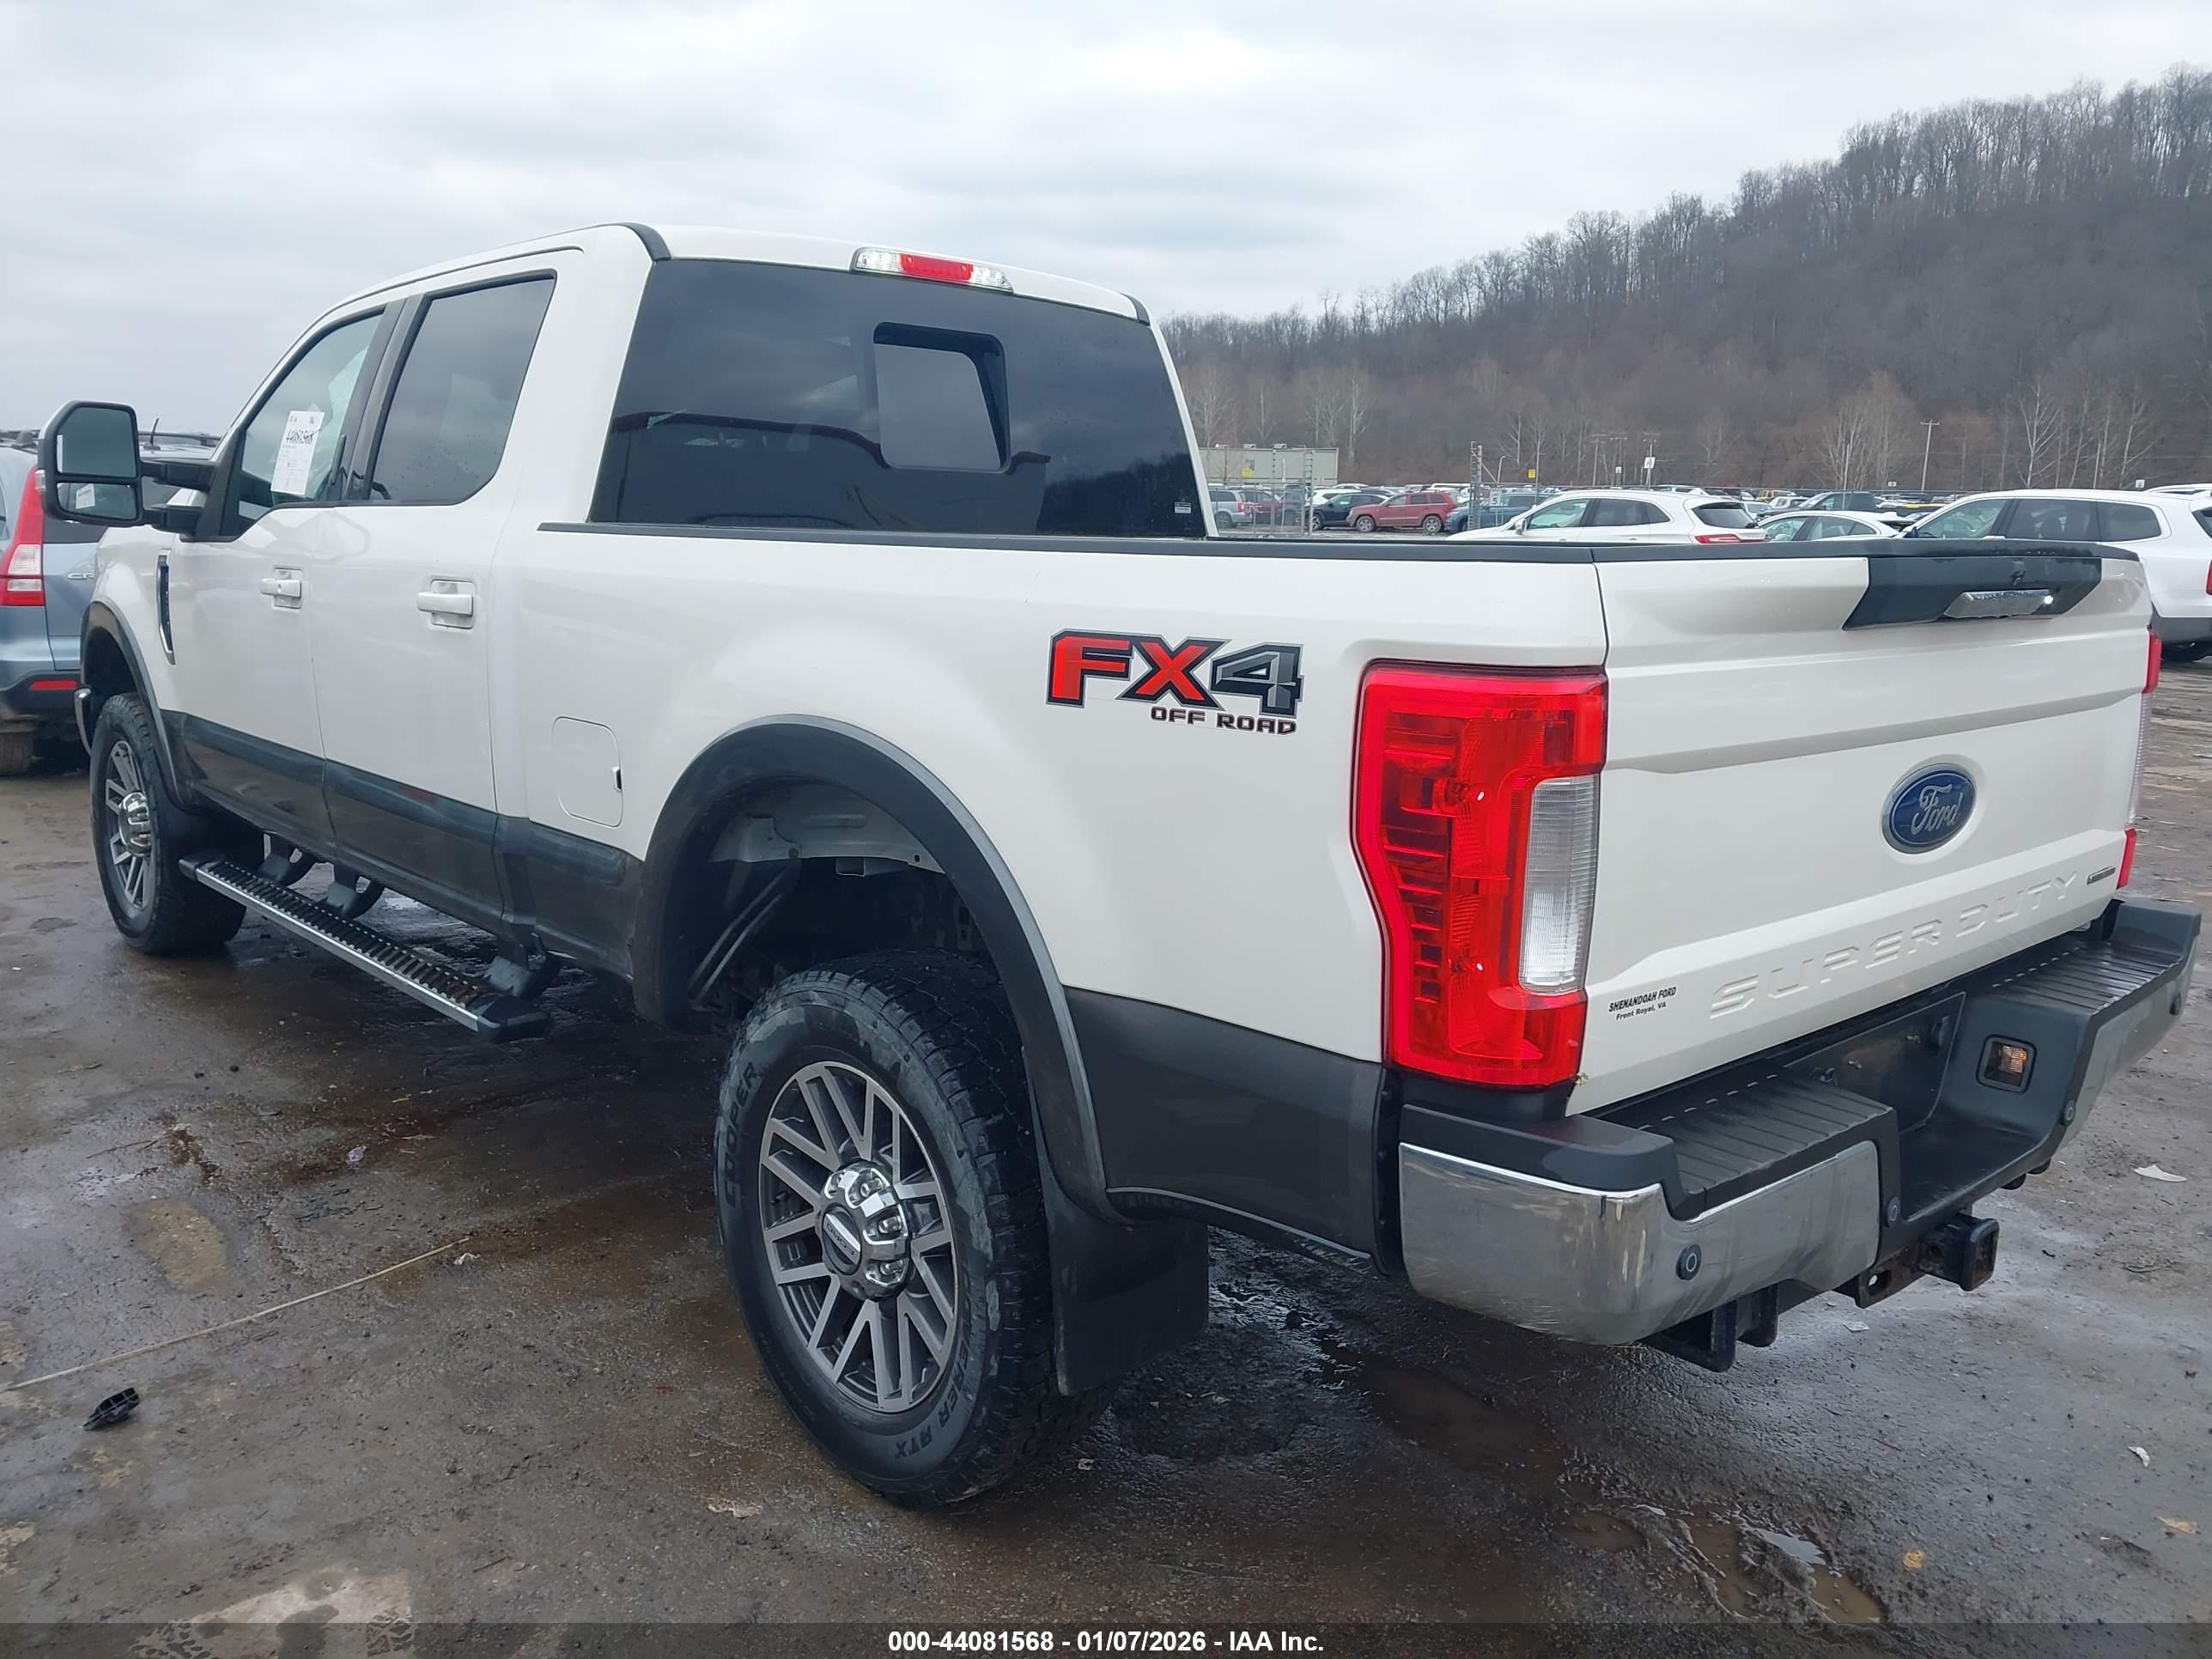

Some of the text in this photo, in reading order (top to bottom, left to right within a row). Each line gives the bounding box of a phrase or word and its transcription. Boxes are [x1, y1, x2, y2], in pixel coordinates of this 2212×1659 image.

[1046, 629, 1304, 718] FX4
[1151, 706, 1297, 736] OFF ROAD
[1911, 783, 1964, 836] Ford
[1710, 872, 2078, 1020] SUPER DUTY
[1608, 986, 1677, 1012] SHENANDOAH FORD
[1615, 1011, 1634, 1021] Front
[725, 1060, 763, 1209] COOPER
[826, 1222, 855, 1256] FORD
[894, 1425, 933, 1460] RTX
